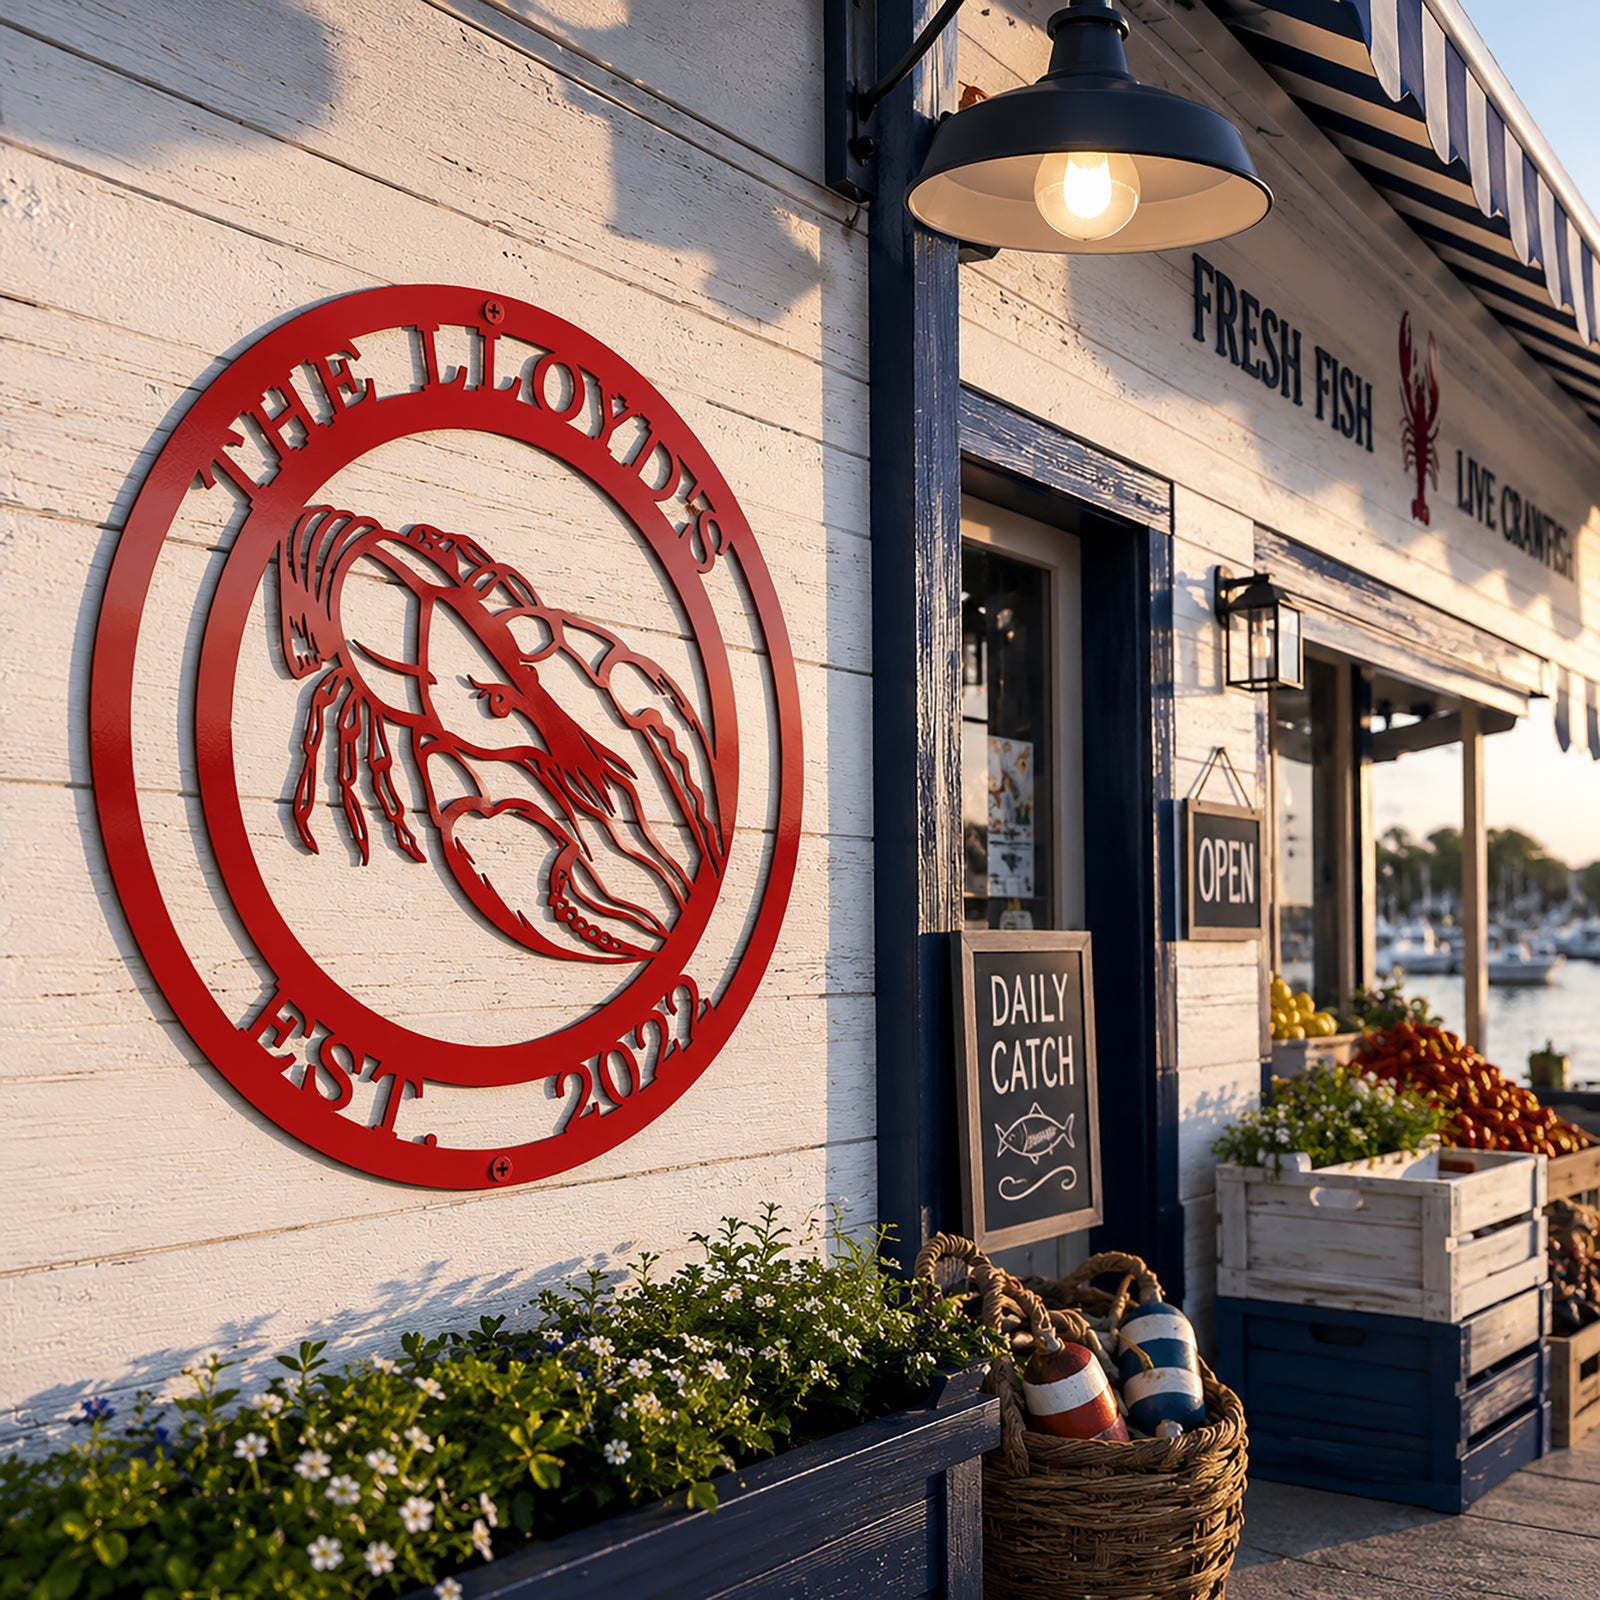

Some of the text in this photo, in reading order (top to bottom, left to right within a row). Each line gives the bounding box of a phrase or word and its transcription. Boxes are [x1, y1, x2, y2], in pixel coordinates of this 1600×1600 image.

[197, 349, 376, 511] THE
[1192, 252, 1303, 407] FRESH
[1315, 346, 1374, 453] FISH
[1456, 450, 1497, 532] LIVE
[1199, 837, 1254, 904] OPEN
[991, 973, 1068, 1027] DAILY
[236, 974, 713, 1147] EST. 2022
[991, 1035, 1075, 1094] CATCH
